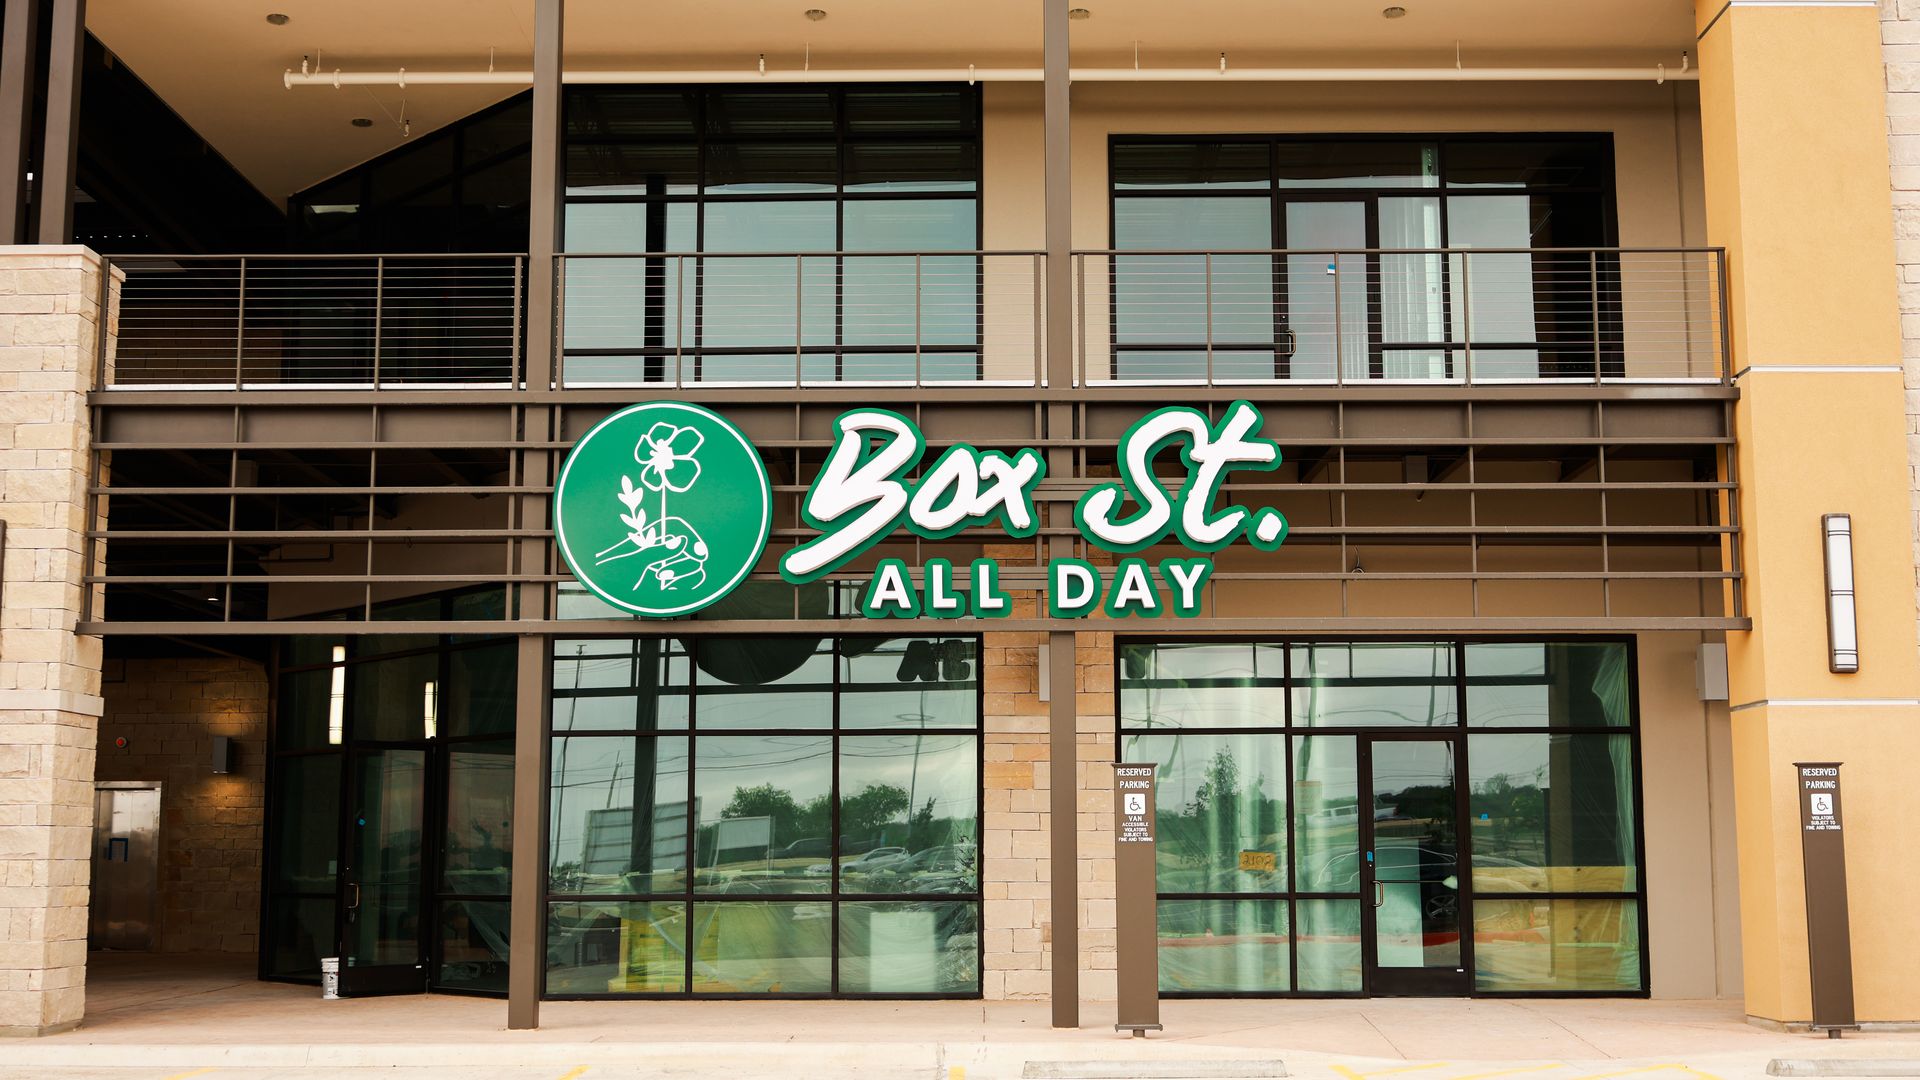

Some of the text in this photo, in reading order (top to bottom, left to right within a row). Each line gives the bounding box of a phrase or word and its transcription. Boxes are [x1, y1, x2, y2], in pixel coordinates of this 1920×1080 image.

[785, 404, 1282, 575] Box St.
[870, 564, 1206, 609] ALL DAY
[1117, 768, 1152, 777] RESERVED
[1802, 768, 1838, 777] RESERVED
[1119, 780, 1150, 789] PARKING
[1805, 780, 1836, 789] PARKING
